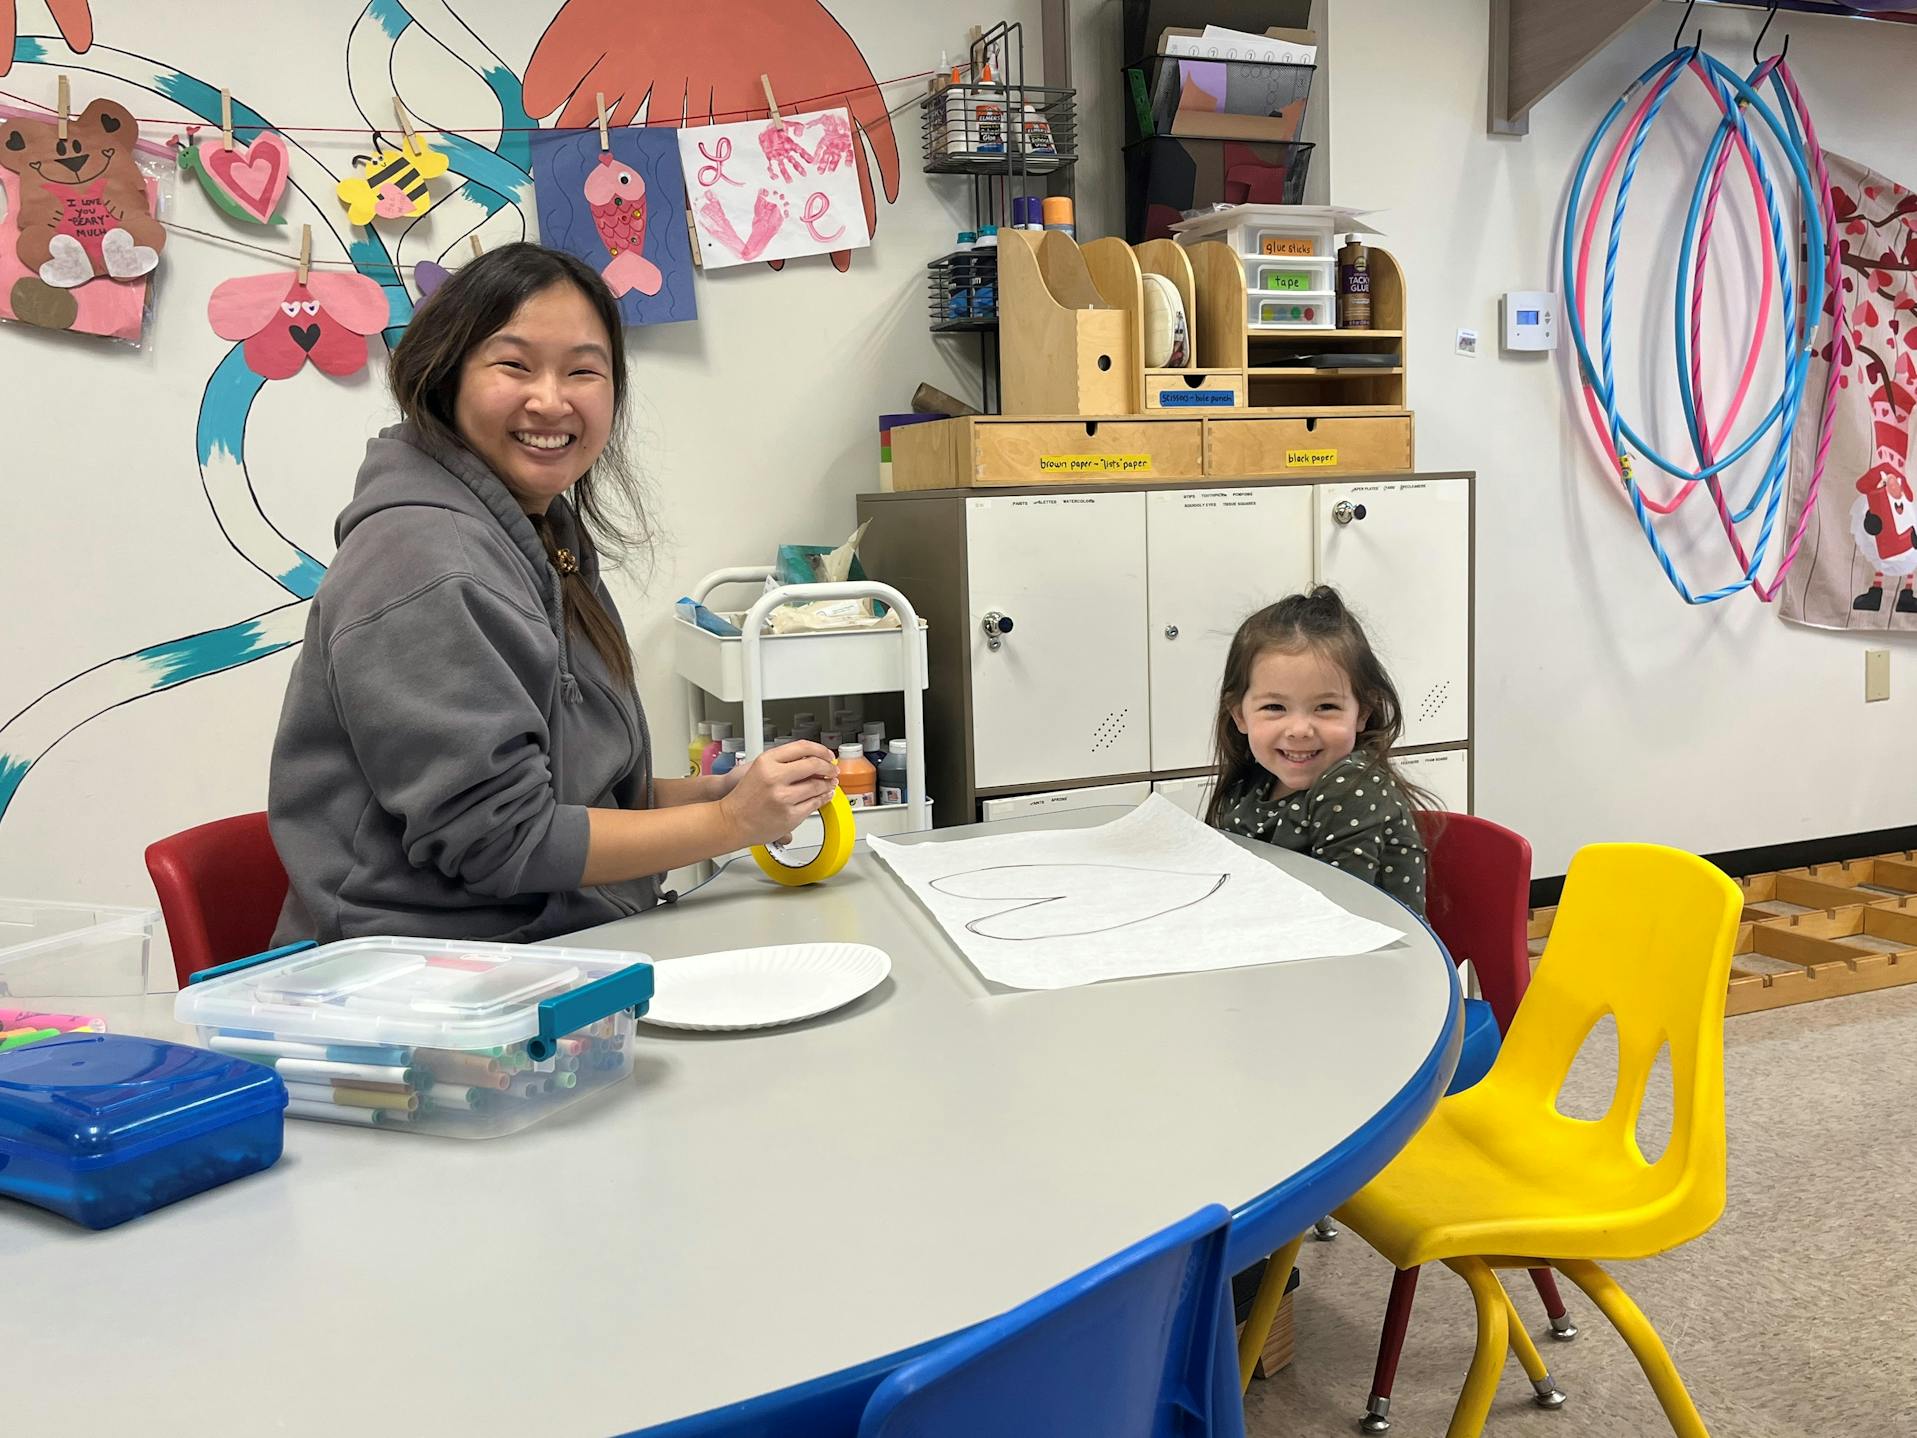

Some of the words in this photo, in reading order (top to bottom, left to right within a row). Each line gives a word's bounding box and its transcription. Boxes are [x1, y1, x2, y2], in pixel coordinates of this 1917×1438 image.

[66, 199, 76, 207] I
[81, 198, 102, 206] LOVE
[75, 208, 97, 218] YOU
[76, 229, 107, 237] MUCH
[1266, 241, 1286, 254] glue
[1288, 244, 1311, 254] sticks
[1275, 276, 1300, 289] tape
[1350, 284, 1370, 292] GLUE
[1288, 453, 1310, 463] black
[1311, 455, 1334, 464] paper
[1040, 458, 1067, 469] brown
[1070, 460, 1092, 470] paper
[1123, 460, 1147, 470] paper
